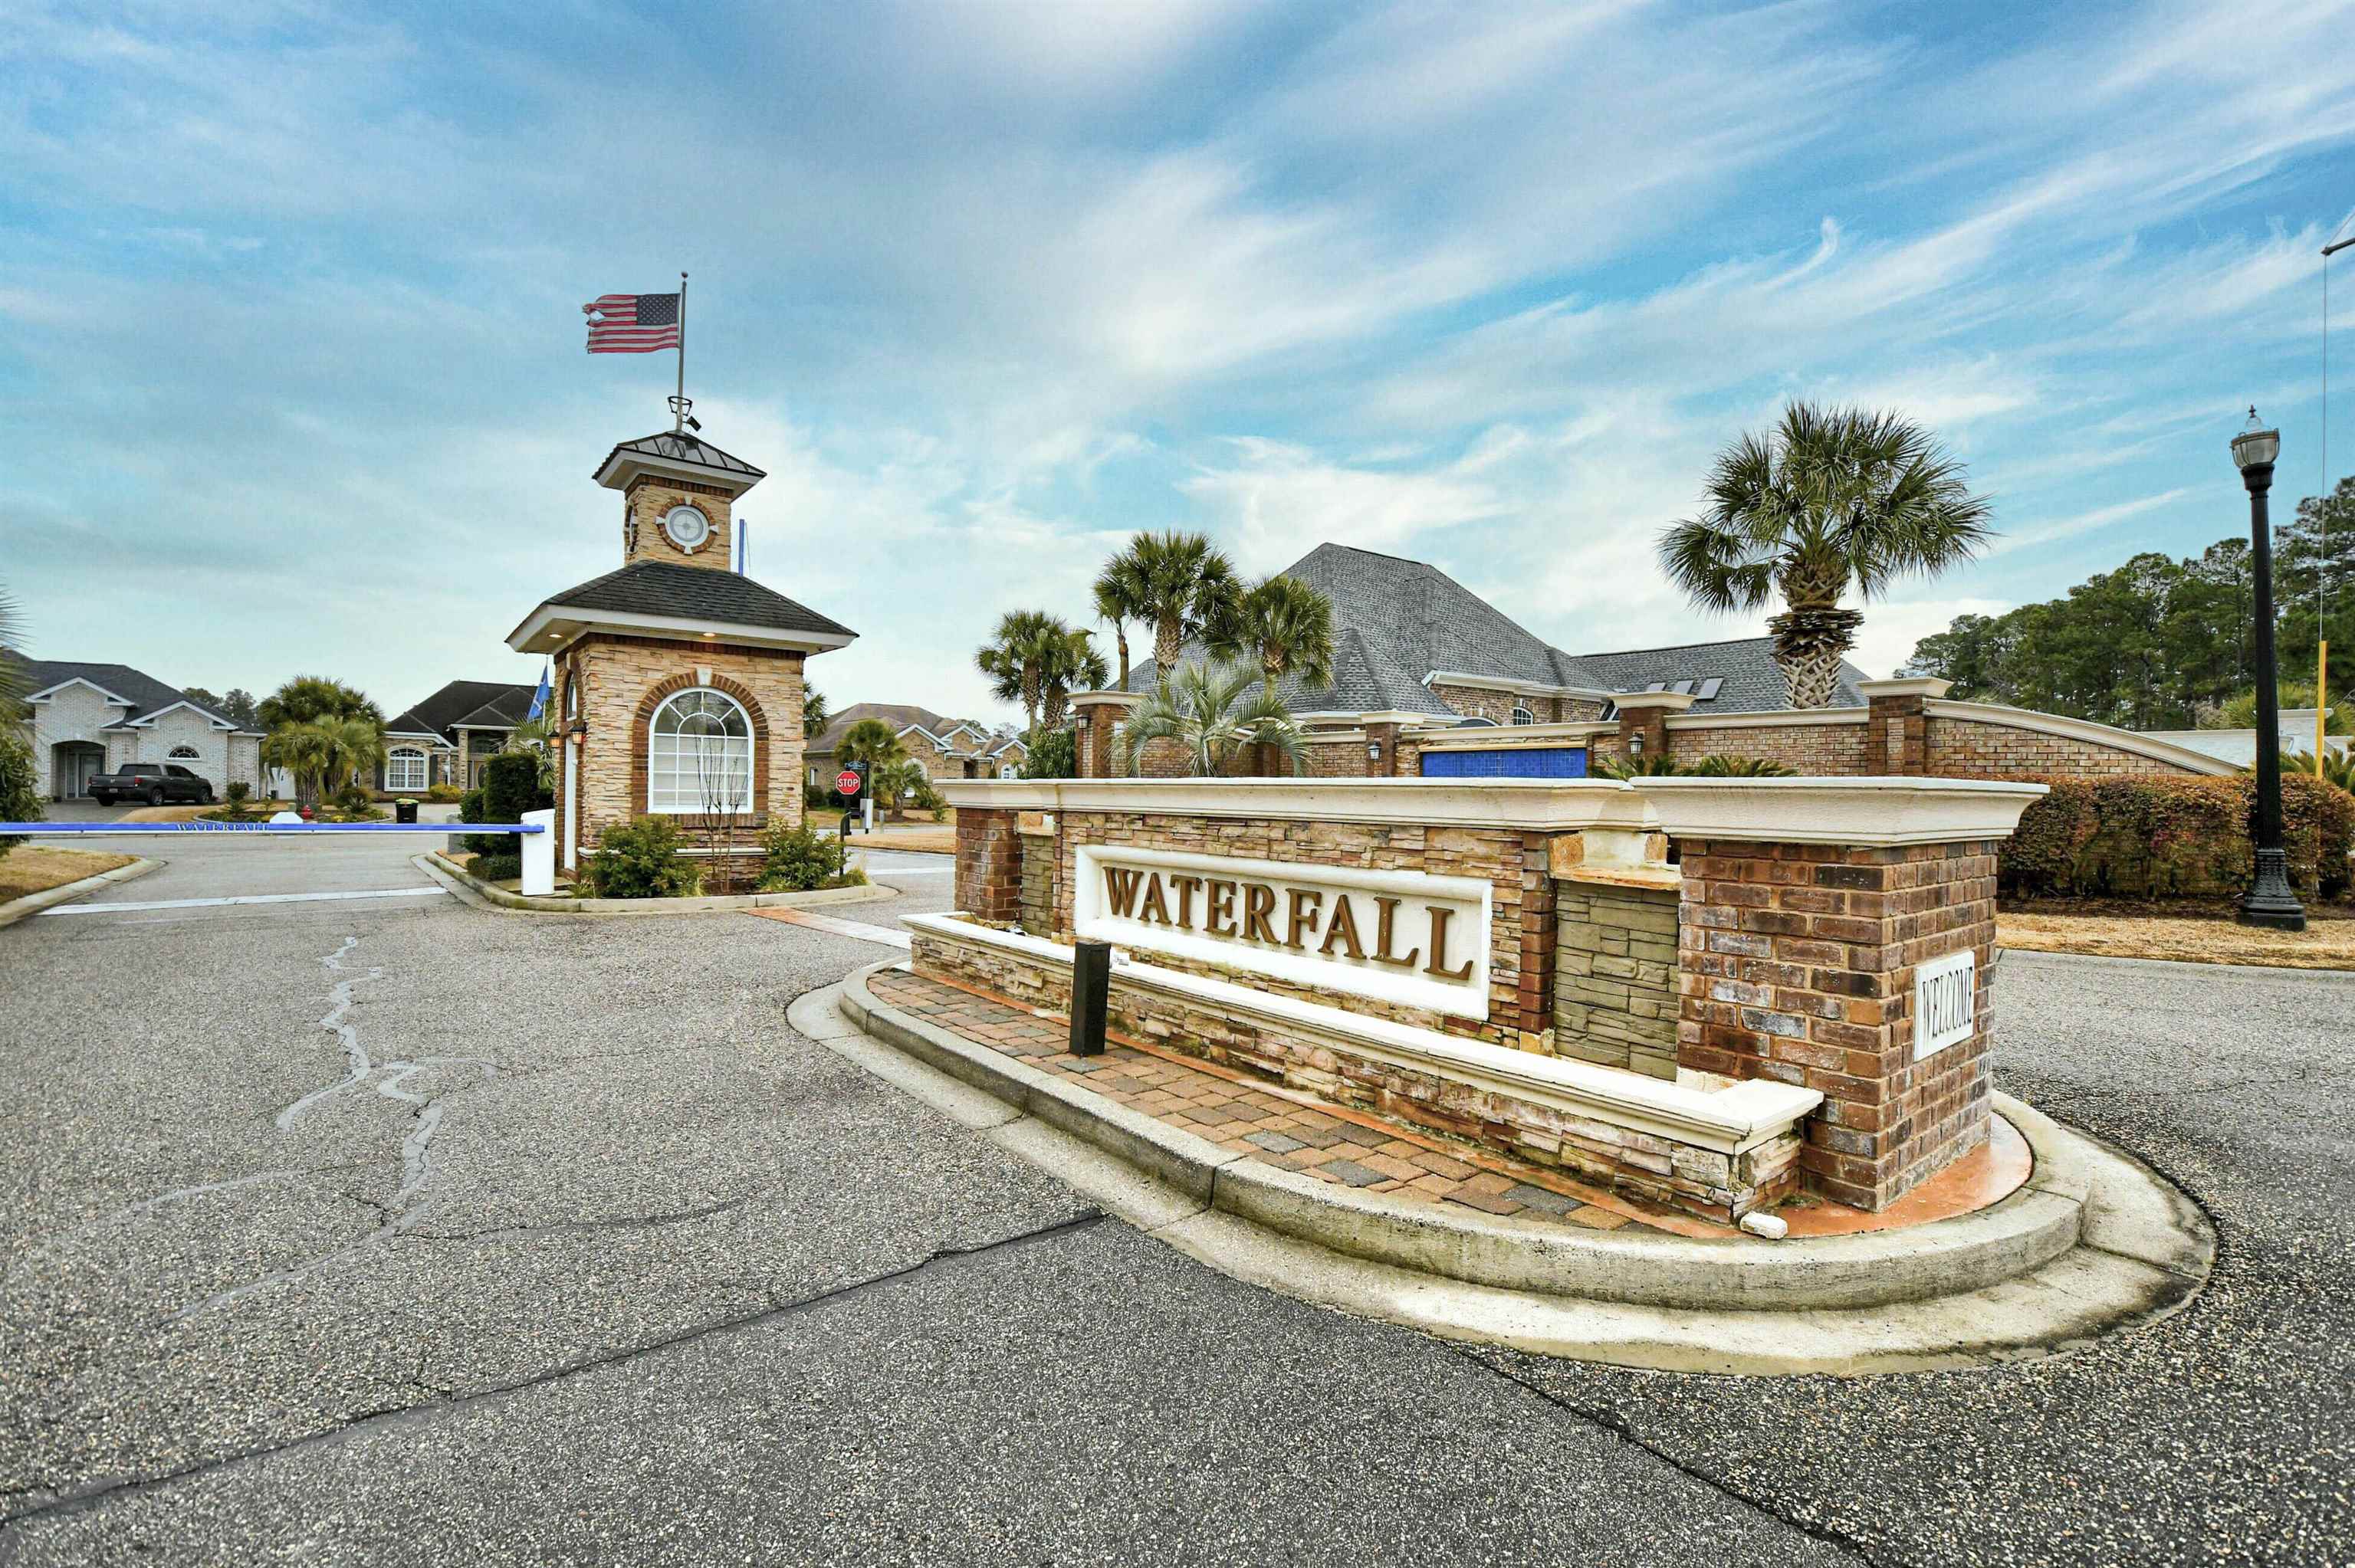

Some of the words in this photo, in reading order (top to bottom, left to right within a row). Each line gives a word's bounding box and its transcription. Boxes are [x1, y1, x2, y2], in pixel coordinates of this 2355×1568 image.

[838, 778, 859, 787] STOP
[176, 823, 268, 832] WATERFALL
[1102, 865, 1473, 981] WATERFALL
[1922, 966, 1973, 1039] WELCOME
